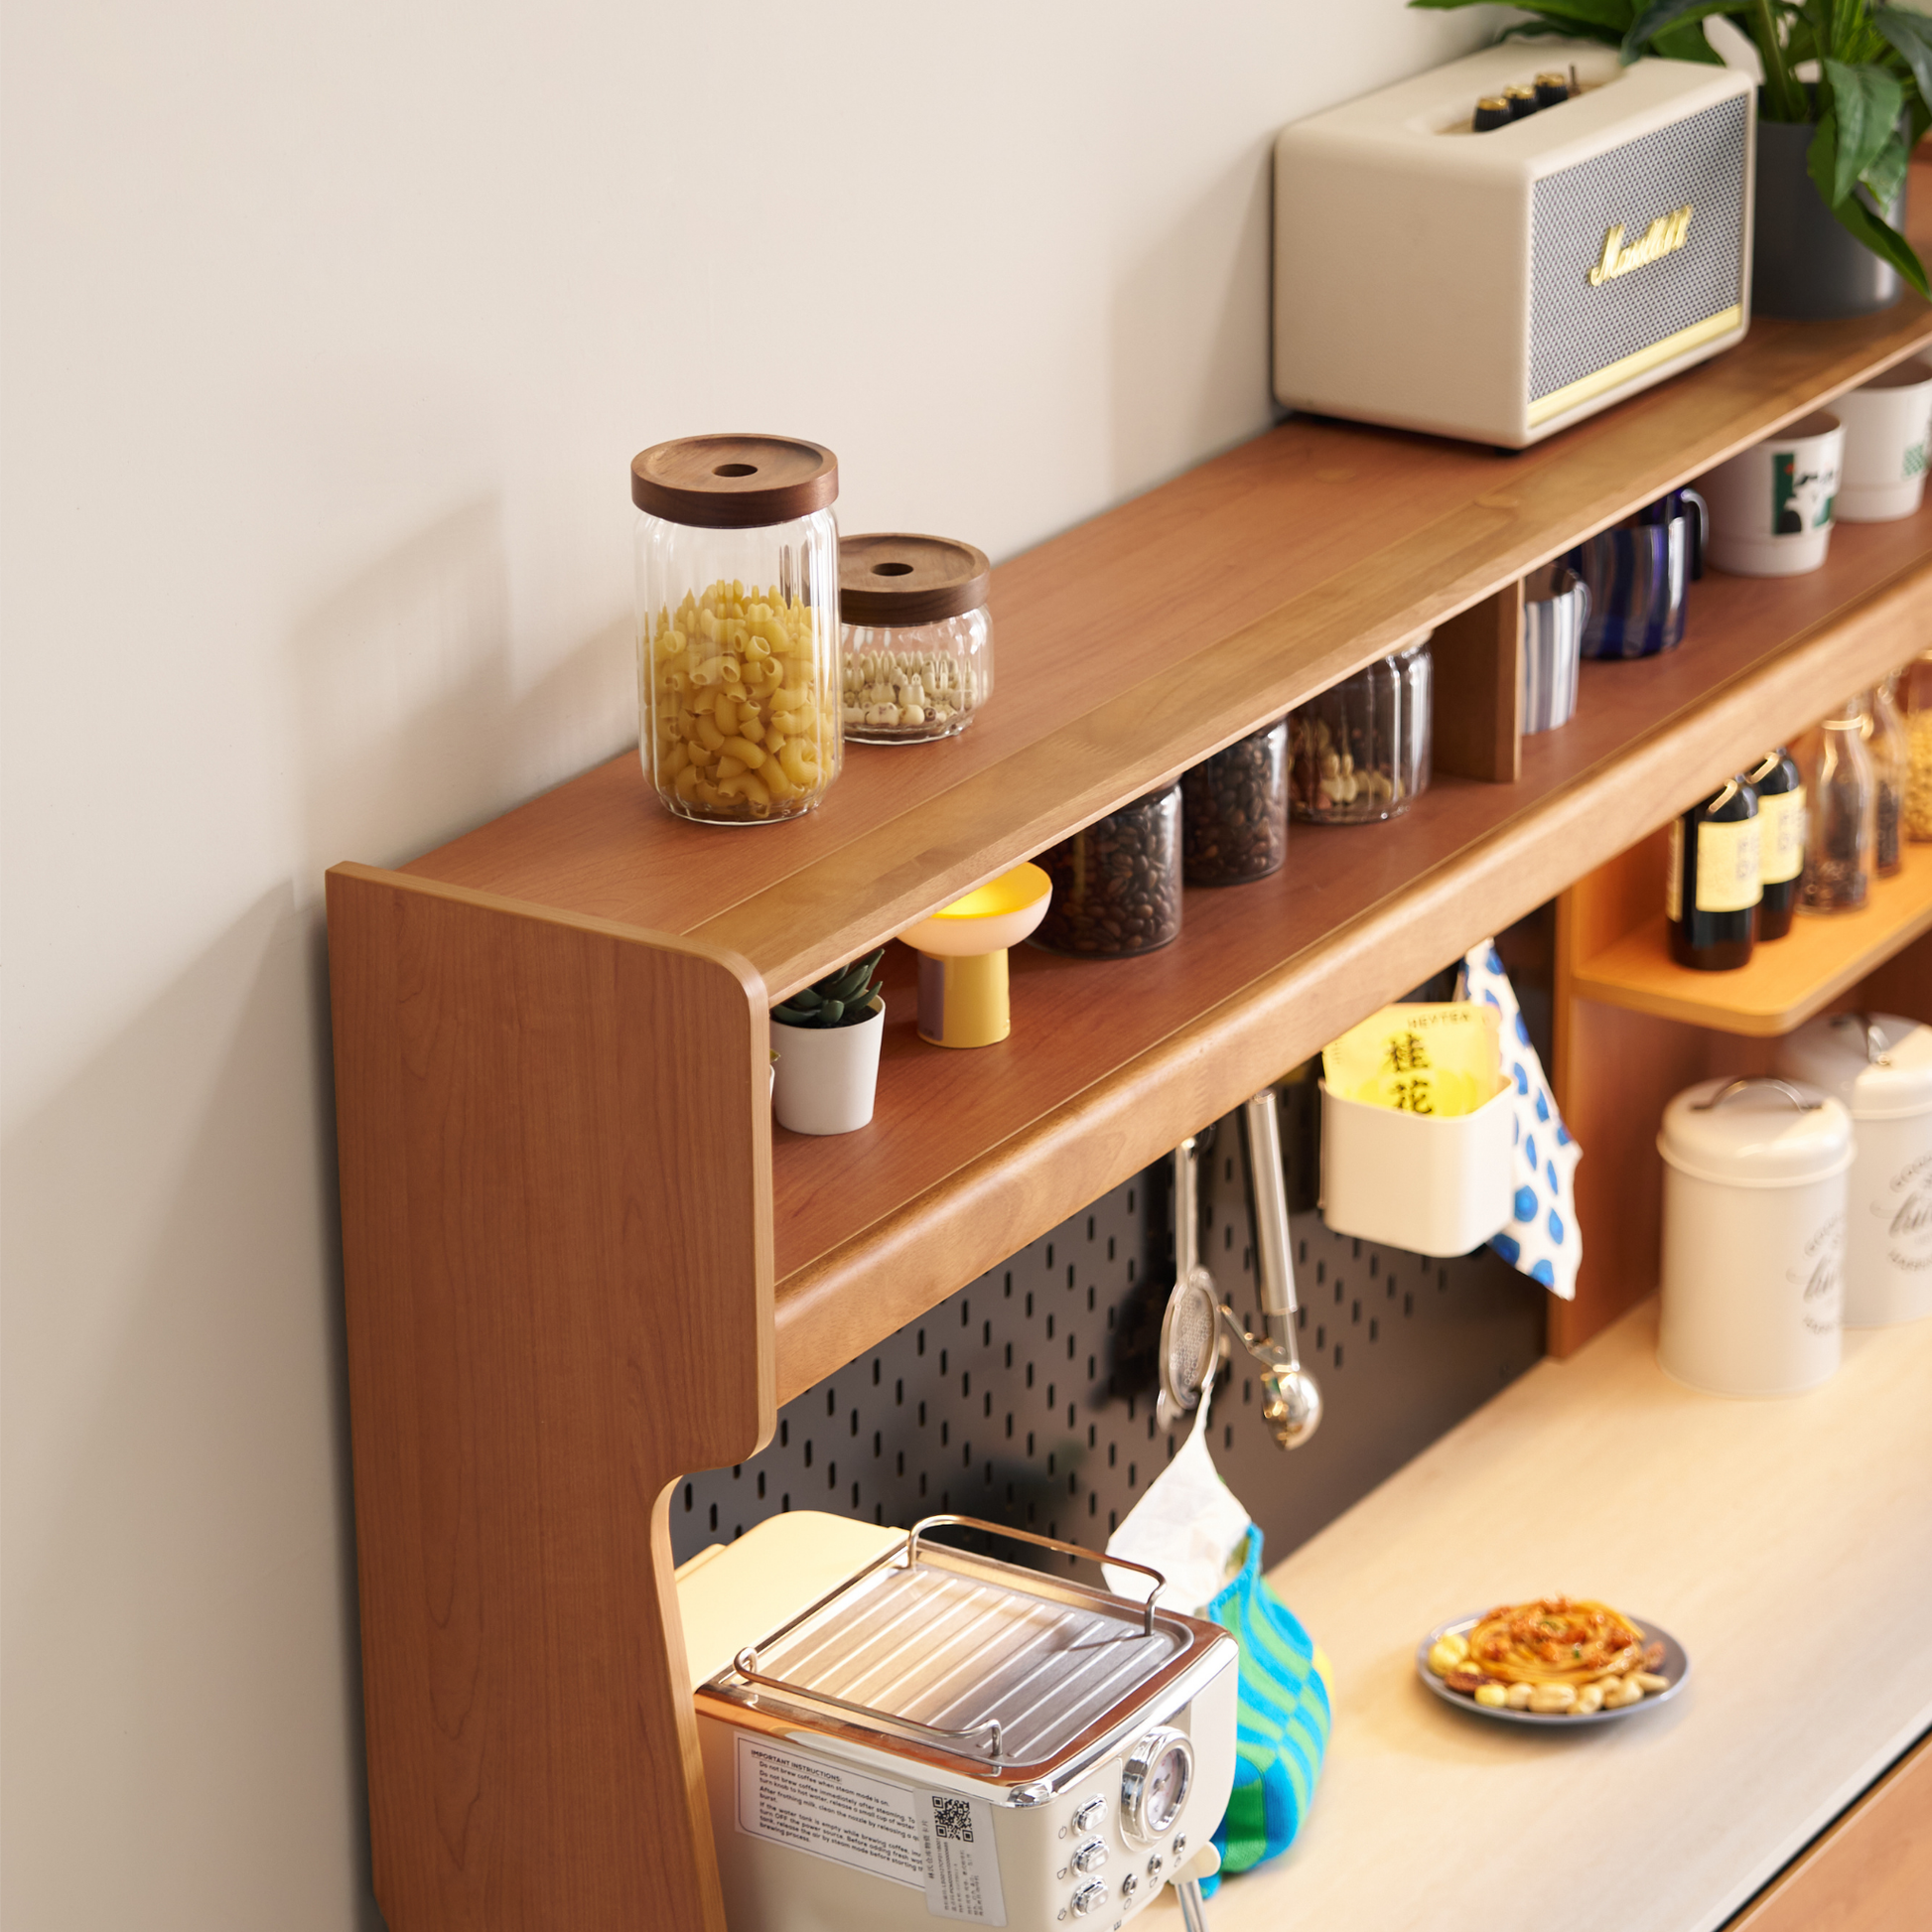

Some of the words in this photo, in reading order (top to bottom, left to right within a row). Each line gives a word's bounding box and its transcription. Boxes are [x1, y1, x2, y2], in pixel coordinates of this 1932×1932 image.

[751, 1749, 790, 1766] IMPORTANT
[791, 1762, 842, 1782] INSTRUCTIONS:
[773, 1781, 789, 1791] knob
[829, 1800, 853, 1811] release
[859, 1809, 876, 1818] small
[780, 1767, 796, 1777] brew
[797, 1774, 817, 1784] coffee
[836, 1786, 855, 1795] steam
[856, 1793, 874, 1802] mode
[781, 1777, 797, 1786] brew
[798, 1783, 818, 1793] coffee
[819, 1789, 858, 1806] immediately
[859, 1802, 875, 1813] after
[759, 1786, 776, 1795] After
[777, 1791, 802, 1806] frothing
[818, 1805, 836, 1814] clean
[877, 1824, 906, 1839] releasing
[759, 1822, 785, 1836] brewing
[774, 1811, 787, 1821] OFF
[801, 1823, 821, 1832] power
[847, 1836, 868, 1848] Before
[869, 1845, 892, 1857] adding
[893, 1851, 909, 1863] fresh
[776, 1821, 799, 1832] release
[800, 1827, 811, 1836] the
[831, 1839, 851, 1849] steam
[851, 1846, 869, 1855] mode
[870, 1851, 891, 1862] before
[892, 1859, 917, 1871] starting
[798, 1814, 812, 1823] tank
[821, 1823, 842, 1833] empty
[843, 1829, 860, 1838] while
[861, 1834, 887, 1848] brewing
